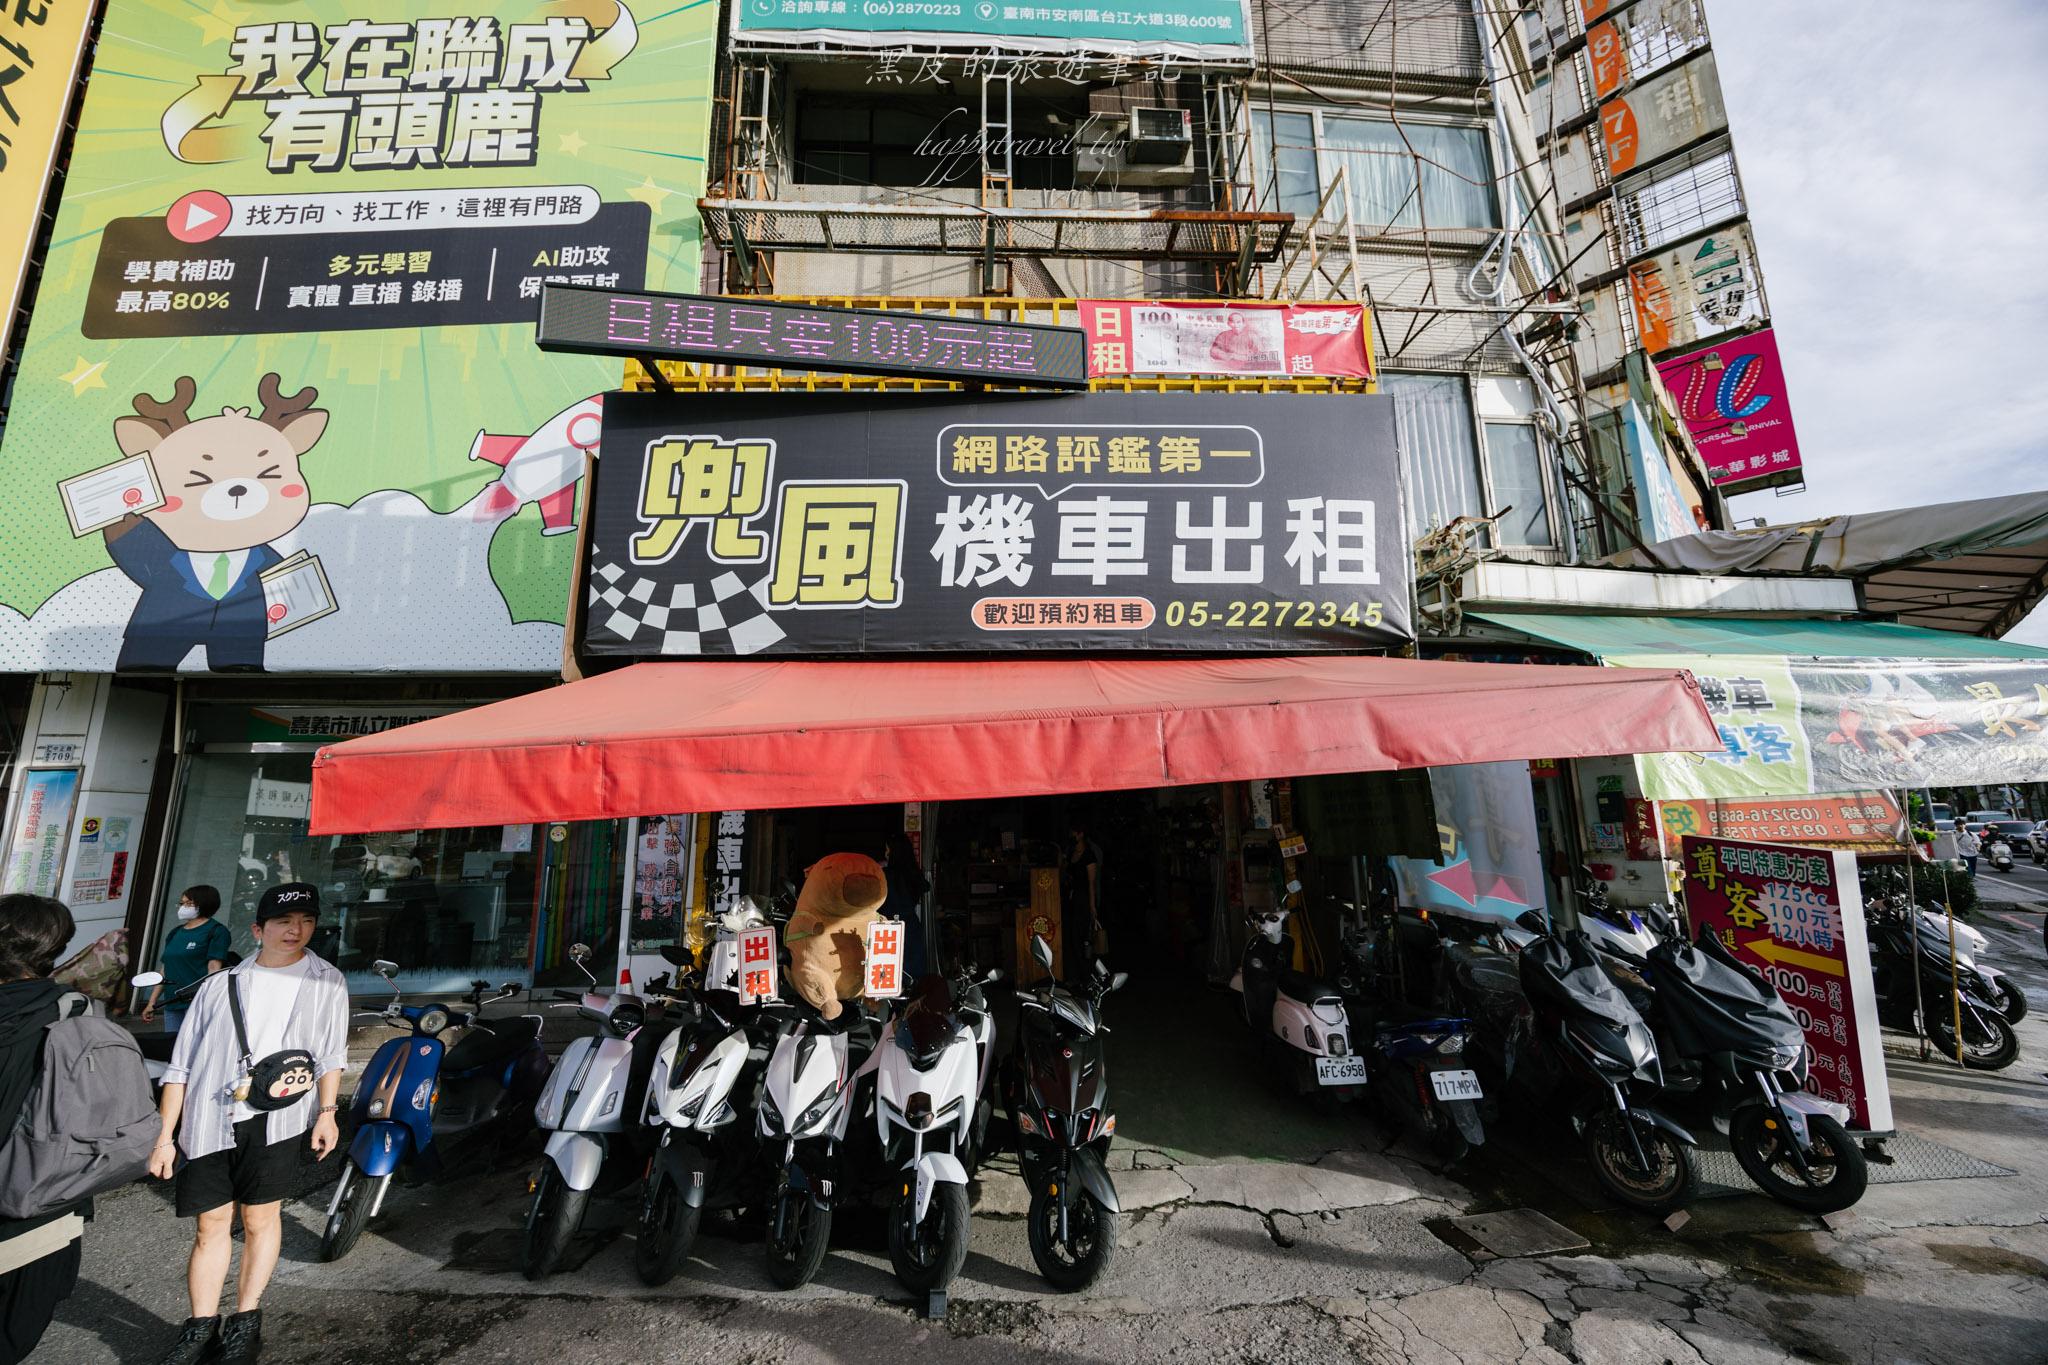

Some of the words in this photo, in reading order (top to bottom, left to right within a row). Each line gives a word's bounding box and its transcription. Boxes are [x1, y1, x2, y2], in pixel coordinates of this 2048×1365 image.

[226, 17, 592, 94] 我在聯成
[262, 91, 546, 174] 有頭鹿
[1605, 109, 1633, 163] 7F
[124, 259, 235, 284] 學費補助
[328, 250, 432, 276] 多元學習
[533, 246, 612, 269] AI助攻
[116, 290, 230, 314] 最高80%
[349, 281, 402, 306] 直播
[411, 278, 464, 304] 錄播
[1139, 311, 1172, 325] 100
[1092, 306, 1128, 374] 日租
[1291, 354, 1314, 374] 起
[951, 433, 1254, 476] 網路評鑑第一
[628, 435, 908, 611] 兜風
[930, 493, 1382, 588] 機車出租
[983, 602, 1145, 626] 歡迎預約租車
[1164, 600, 1383, 629] 05-2272345
[52, 752, 71, 761] 709
[714, 810, 746, 940] 機車出
[1721, 846, 1831, 886] 平日特惠方案
[277, 890, 312, 904] スクワード
[1770, 902, 1830, 930] 100元
[1772, 922, 1834, 951] 12小時
[743, 935, 773, 997] 出租
[870, 928, 898, 990] 出租
[1434, 1079, 1480, 1096] 717-MPW
